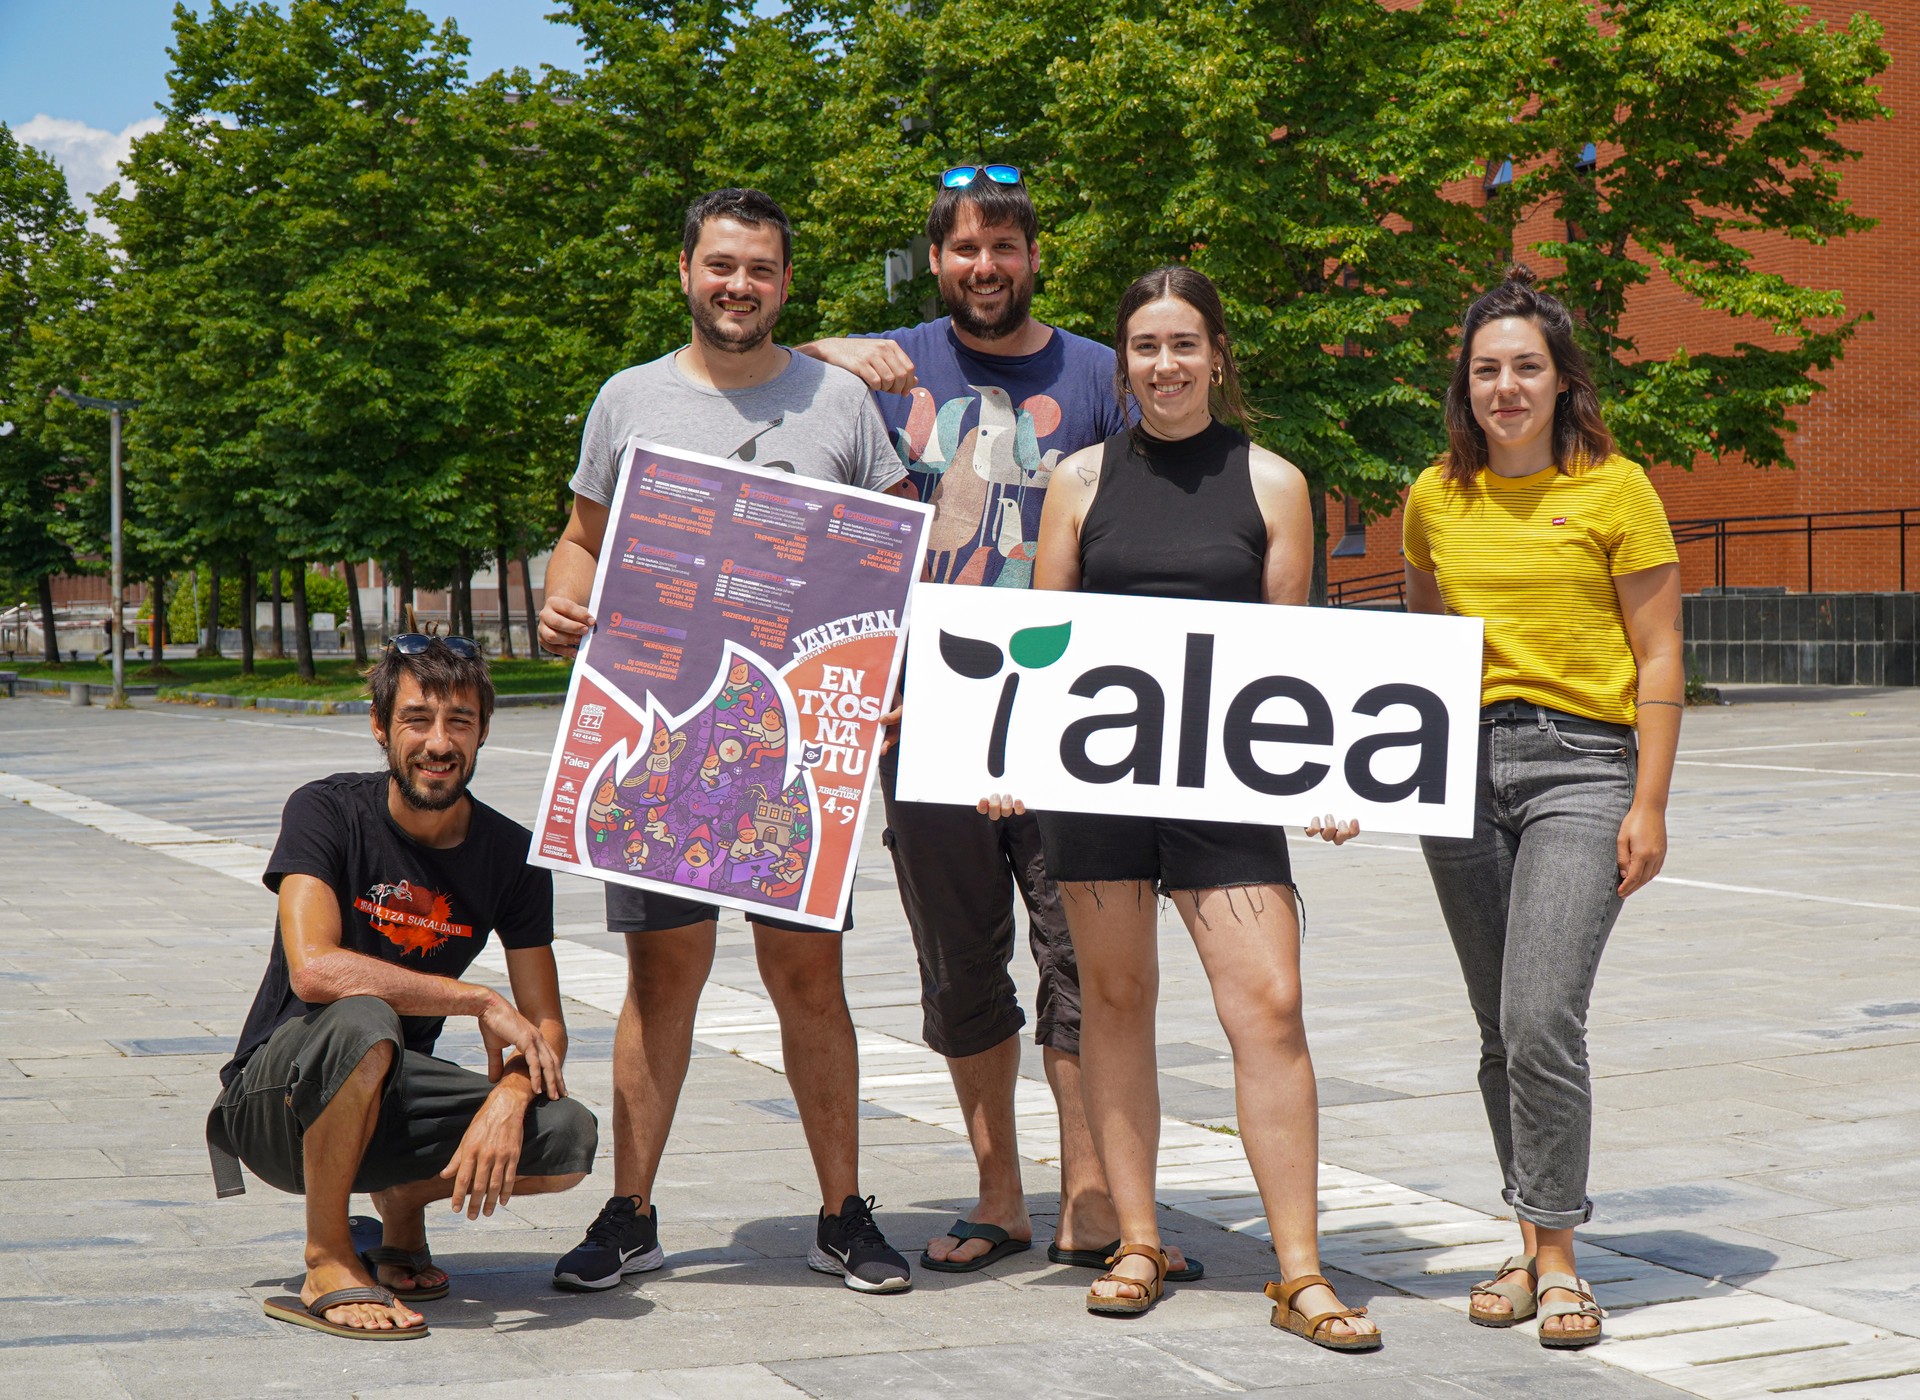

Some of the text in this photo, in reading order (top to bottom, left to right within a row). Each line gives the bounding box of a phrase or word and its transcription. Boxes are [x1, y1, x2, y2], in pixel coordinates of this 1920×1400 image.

[644, 463, 658, 477] 4
[739, 483, 751, 499] 5
[833, 503, 845, 519] 6
[658, 513, 712, 529] WILLIS DRUMMOND
[686, 526, 710, 535] SISTEMA
[626, 537, 639, 553] 7
[755, 534, 806, 549] TREMENDA JAURIA
[774, 544, 789, 552] SARA
[877, 550, 902, 559] ZETALAU
[721, 559, 734, 574] 8
[867, 561, 899, 572] MALANDRO
[656, 583, 680, 592] BRIGADE
[672, 579, 698, 589] TATXERS
[661, 591, 684, 599] ROTTEN
[667, 599, 693, 608] SKAROLO
[610, 612, 623, 628] 9
[723, 611, 787, 630] SOZIEDAD ALKOHOLIKA
[759, 633, 784, 643] VILLATEK
[644, 642, 682, 654] HERENEGUNA
[660, 659, 679, 667] DUPLA
[663, 653, 681, 661] ZETAK
[621, 665, 656, 676] DANTZETAN
[820, 664, 865, 695] EN
[798, 689, 880, 721] TXOS
[579, 713, 602, 729] EZ!
[815, 717, 860, 746] NA
[822, 744, 866, 775] TU
[553, 804, 573, 814] berria
[408, 915, 461, 934] SUKALDATU
